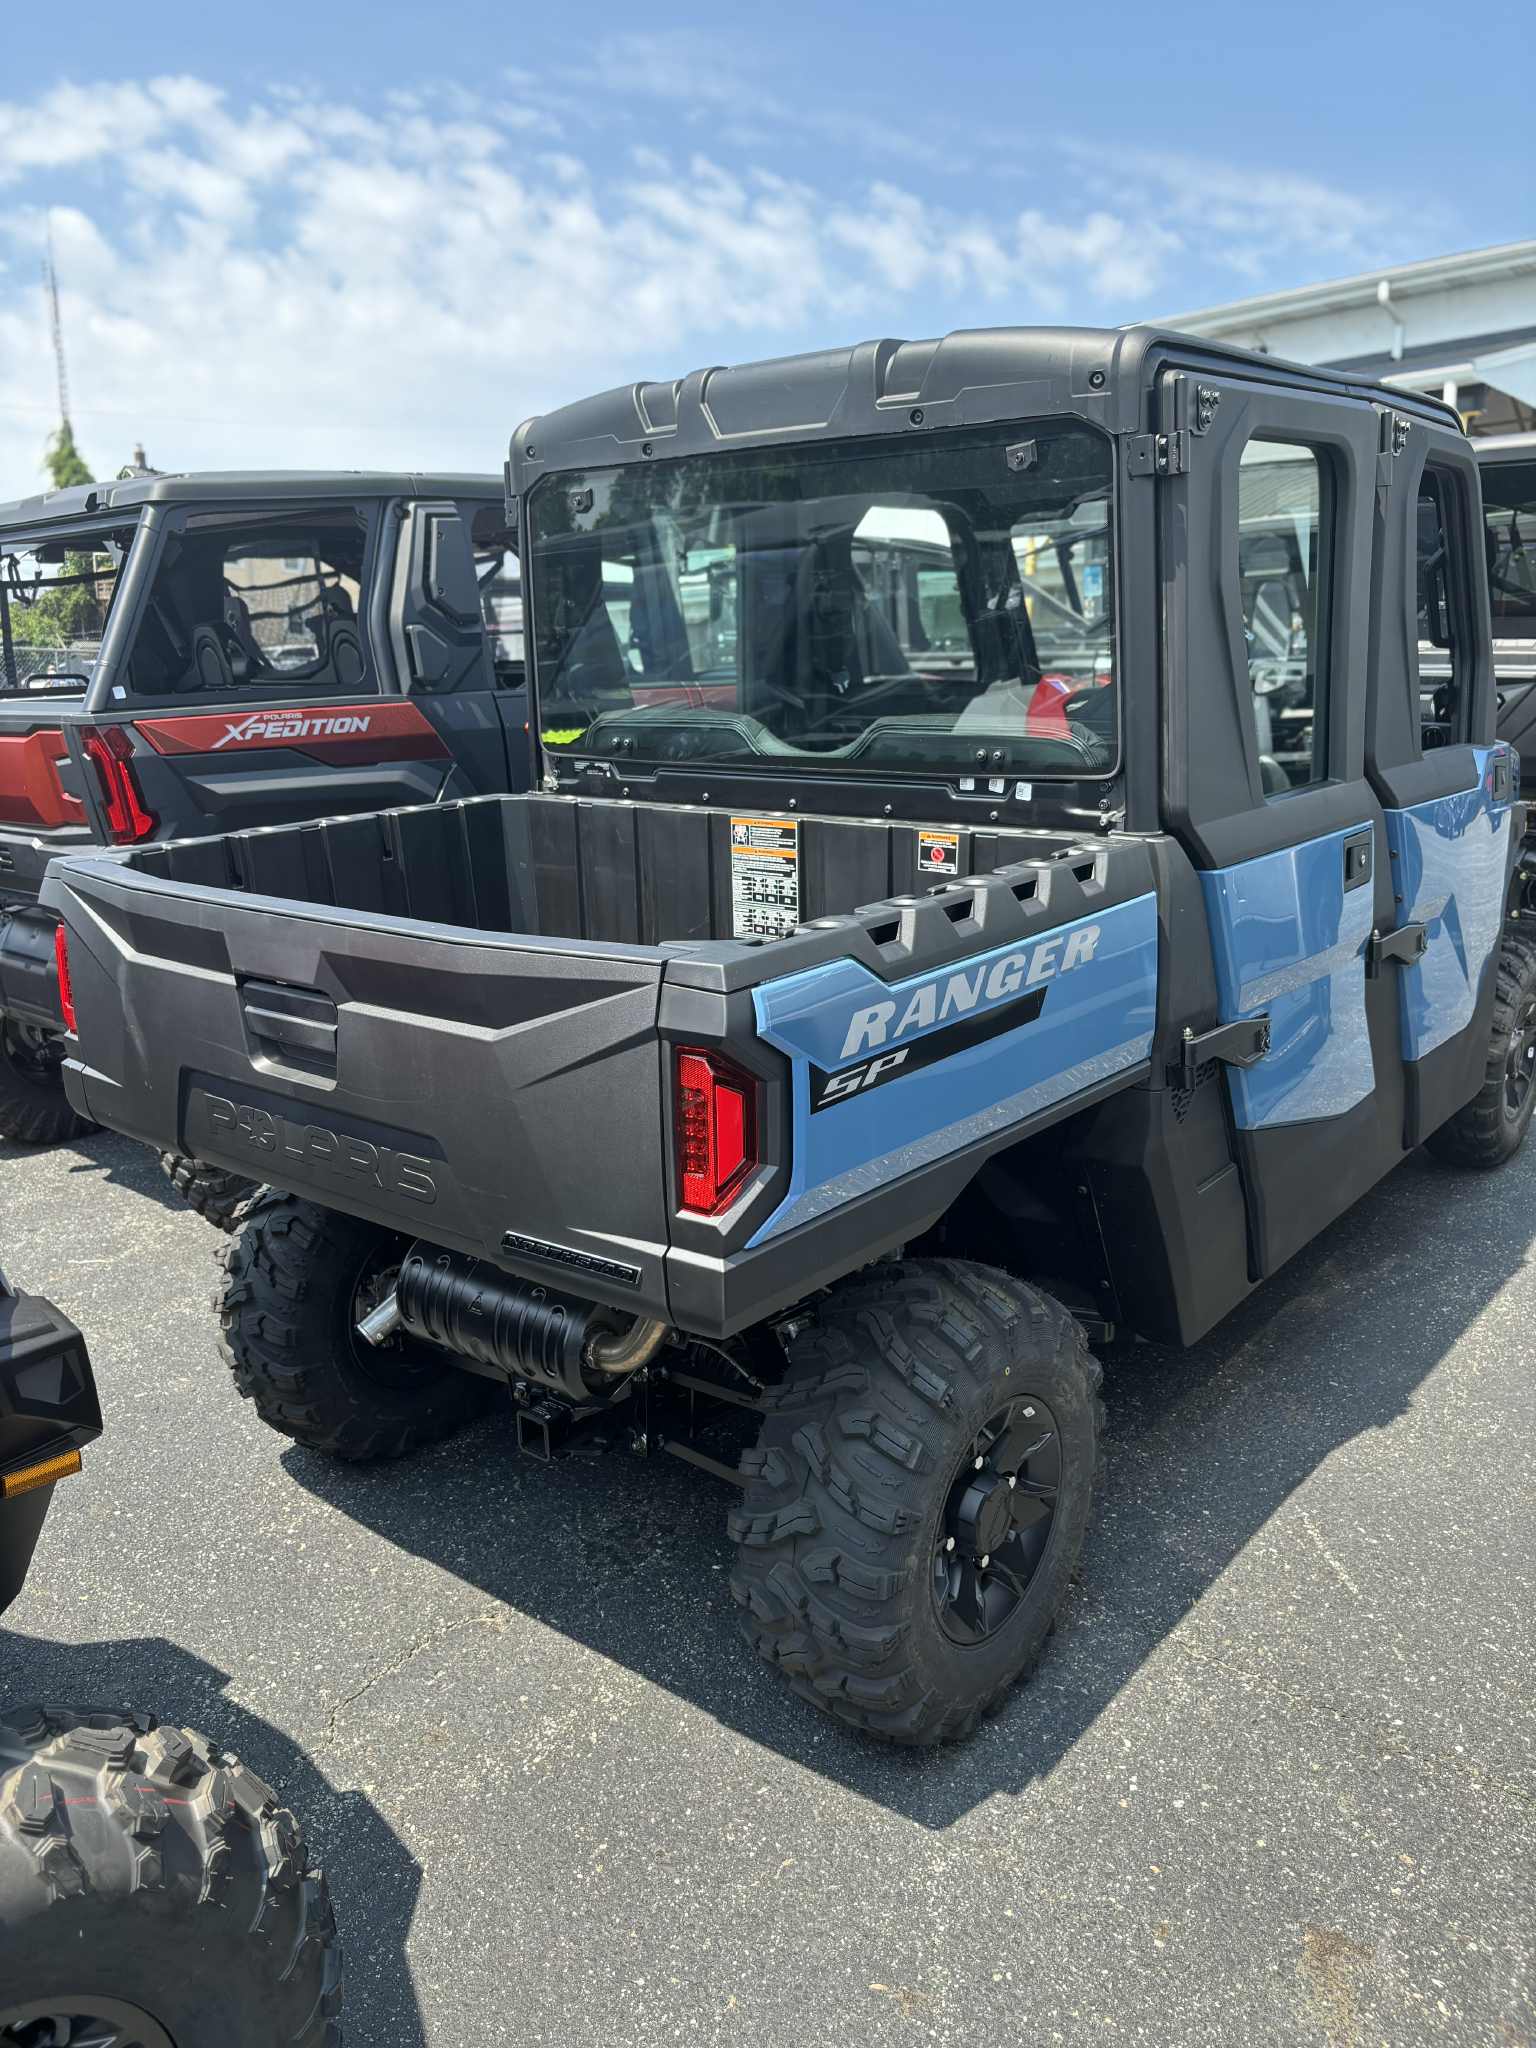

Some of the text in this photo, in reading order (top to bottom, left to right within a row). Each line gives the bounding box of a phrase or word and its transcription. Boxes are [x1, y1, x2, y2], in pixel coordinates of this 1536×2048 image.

[211, 715, 371, 749] XPEDITION
[263, 712, 304, 721] POLARIS
[840, 924, 1101, 1060] RANGER
[817, 1048, 910, 1106] SP
[204, 1091, 437, 1205] POLARIS
